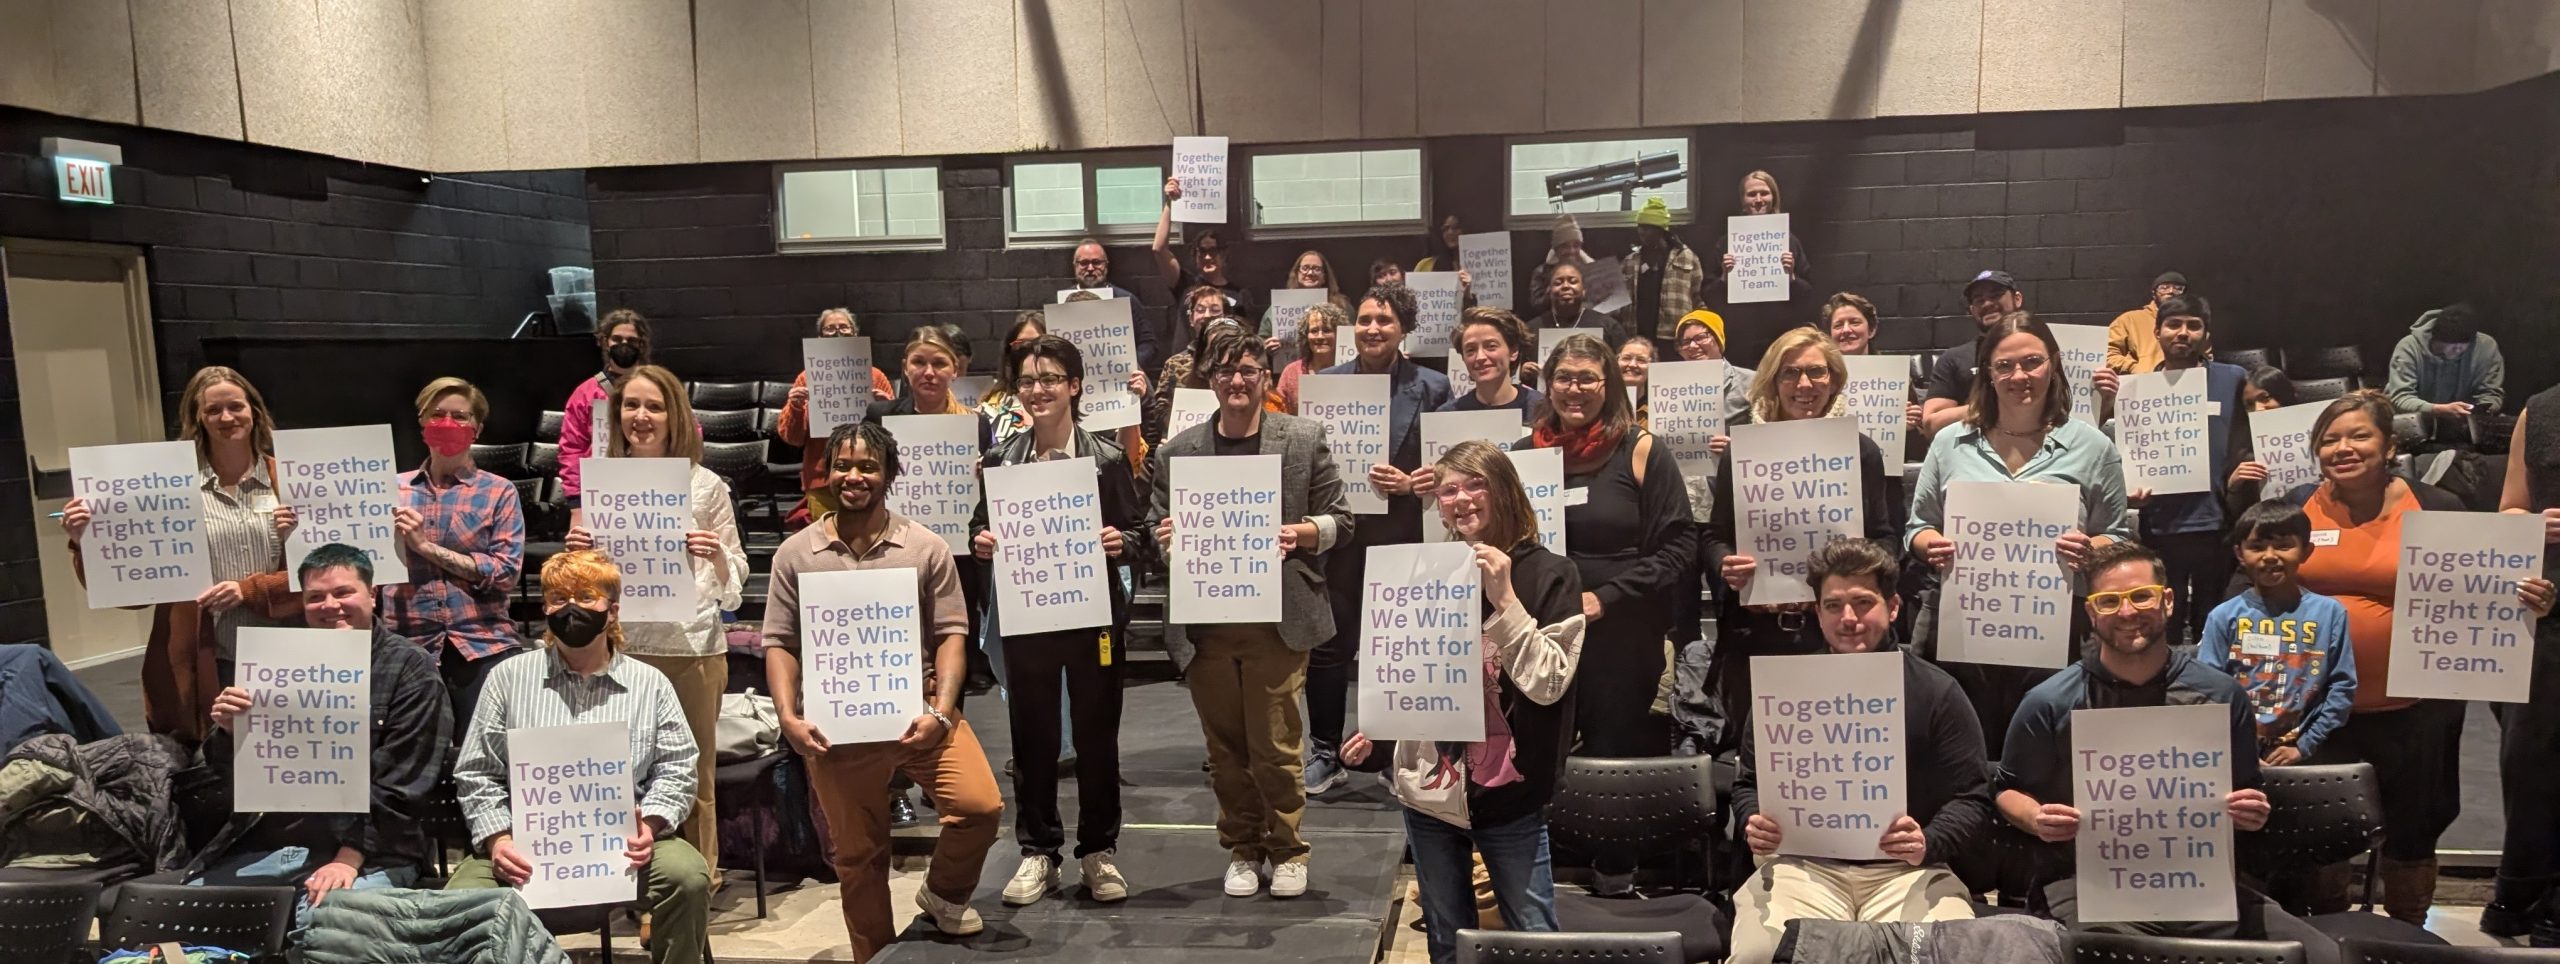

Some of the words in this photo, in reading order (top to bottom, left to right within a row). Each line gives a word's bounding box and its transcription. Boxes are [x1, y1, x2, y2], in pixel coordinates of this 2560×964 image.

[1176, 153, 1225, 165] Together
[1177, 165, 1194, 174] We
[66, 163, 105, 197] EXIT
[1208, 177, 1223, 186] for
[1731, 231, 1786, 243] Together
[1733, 244, 1752, 253] We
[1756, 242, 1782, 252] Win:
[1737, 268, 1757, 277] the
[1760, 267, 1767, 276] T
[1771, 266, 1781, 275] in
[1741, 280, 1777, 289] Team.
[1650, 383, 1719, 400] Together
[1863, 394, 1899, 407] Win:
[1302, 401, 1385, 421] Together
[1653, 401, 1678, 413] We
[1683, 399, 1715, 412] Win:
[2118, 393, 2201, 412] Together
[1340, 420, 1379, 435] Win:
[1656, 416, 1692, 433] Fight
[1697, 415, 1718, 428] for
[2122, 414, 2151, 427] We
[2157, 410, 2197, 424] Win:
[1357, 440, 1382, 454] for
[2125, 429, 2170, 448] Fight
[2175, 427, 2200, 440] for
[2129, 447, 2159, 461] the
[2164, 445, 2175, 458] T
[2181, 444, 2196, 457] in
[281, 456, 389, 480] Together
[928, 460, 970, 475] Win:
[1736, 454, 1853, 481] Together
[2136, 464, 2191, 477] Team.
[78, 472, 193, 496] Together
[288, 482, 327, 499] We
[334, 478, 386, 496] Win:
[947, 480, 973, 495] for
[1743, 484, 1784, 503] We
[1792, 479, 1847, 499] Win:
[86, 498, 127, 515] We
[135, 494, 190, 512] Win:
[359, 500, 391, 517] for
[586, 489, 686, 512] Together
[992, 492, 1093, 519] Together
[1175, 487, 1276, 510] Together
[92, 519, 155, 542] Fight
[161, 516, 196, 533] for
[591, 513, 626, 529] We
[633, 512, 681, 529] Win:
[999, 521, 1035, 539] We
[1041, 515, 1090, 535] Win:
[1179, 512, 1214, 528] We
[1222, 510, 1269, 527] Win:
[1748, 507, 1810, 534] Fight
[1817, 504, 1852, 523] for
[1950, 515, 2071, 544] Together
[100, 542, 143, 559] the
[149, 539, 164, 556] T
[171, 538, 194, 555] in
[1004, 542, 1059, 567] Fight
[1065, 538, 1096, 556] for
[1182, 534, 1236, 557] Fight
[1242, 533, 1273, 550] for
[1754, 533, 1796, 553] the
[1954, 541, 1995, 561] We
[1186, 557, 1223, 574] the
[1229, 557, 1242, 574] T
[1249, 556, 1267, 573] in
[2406, 546, 2536, 575] Together
[111, 565, 189, 581] Team.
[1011, 567, 1048, 585] the
[1054, 563, 1067, 580] T
[1074, 561, 1093, 579] in
[1955, 567, 2019, 592] Fight
[2409, 572, 2453, 593] We
[1020, 590, 1089, 607] Team.
[1193, 581, 1260, 597] Team.
[1367, 580, 1475, 607] Together
[1959, 592, 2001, 612] the
[2010, 594, 2025, 613] T
[2033, 595, 2054, 615] in
[2408, 598, 2478, 625] Fight
[2487, 601, 2527, 621] for
[806, 602, 914, 627] Together
[1371, 609, 1407, 628] We
[1416, 607, 1468, 628] Win:
[811, 629, 849, 647] We
[857, 626, 908, 644] Win:
[1966, 617, 2044, 640] Team.
[2412, 624, 2458, 645] the
[2467, 626, 2485, 646] T
[2492, 627, 2516, 647] in
[1373, 635, 1430, 662] Fight
[1438, 635, 1472, 655] for
[815, 651, 873, 676] Fight
[880, 649, 913, 667] for
[2419, 650, 2503, 672] Team.
[240, 663, 363, 690] Together
[821, 676, 860, 694] the
[867, 674, 881, 691] T
[888, 673, 907, 691] in
[1377, 662, 1416, 683] the
[1423, 663, 1438, 683] T
[1445, 662, 1466, 684] in
[247, 689, 288, 708] We
[297, 689, 355, 709] Win:
[829, 700, 901, 717] Team.
[1384, 690, 1458, 713] Team.
[1758, 693, 1897, 722] Together
[249, 714, 315, 740] Fight
[323, 715, 360, 734] for
[1765, 724, 1813, 744] We
[1823, 722, 1888, 744] Win:
[254, 739, 299, 759] the
[307, 740, 323, 759] T
[331, 740, 353, 759] in
[516, 758, 627, 785] Together
[1771, 752, 1844, 780] Fight
[1852, 751, 1895, 772] for
[2079, 746, 2223, 777] Together
[263, 765, 344, 785] Team.
[521, 787, 561, 806] We
[569, 782, 621, 803] Win:
[1778, 780, 1827, 801] the
[1835, 780, 1853, 800] T
[1862, 779, 1888, 800] in
[2086, 779, 2136, 801] We
[2146, 776, 2215, 799] Win:
[526, 810, 586, 837] Fight
[593, 807, 627, 826] for
[1788, 808, 1879, 828] Team.
[2091, 808, 2168, 838] Fight
[2177, 806, 2221, 828] for
[532, 837, 573, 856] the
[579, 834, 594, 852] T
[601, 832, 622, 851] in
[2098, 838, 2150, 860] the
[2159, 837, 2177, 858] T
[2187, 836, 2214, 858] in
[541, 862, 616, 881] Team.
[2109, 868, 2205, 889] Team.
